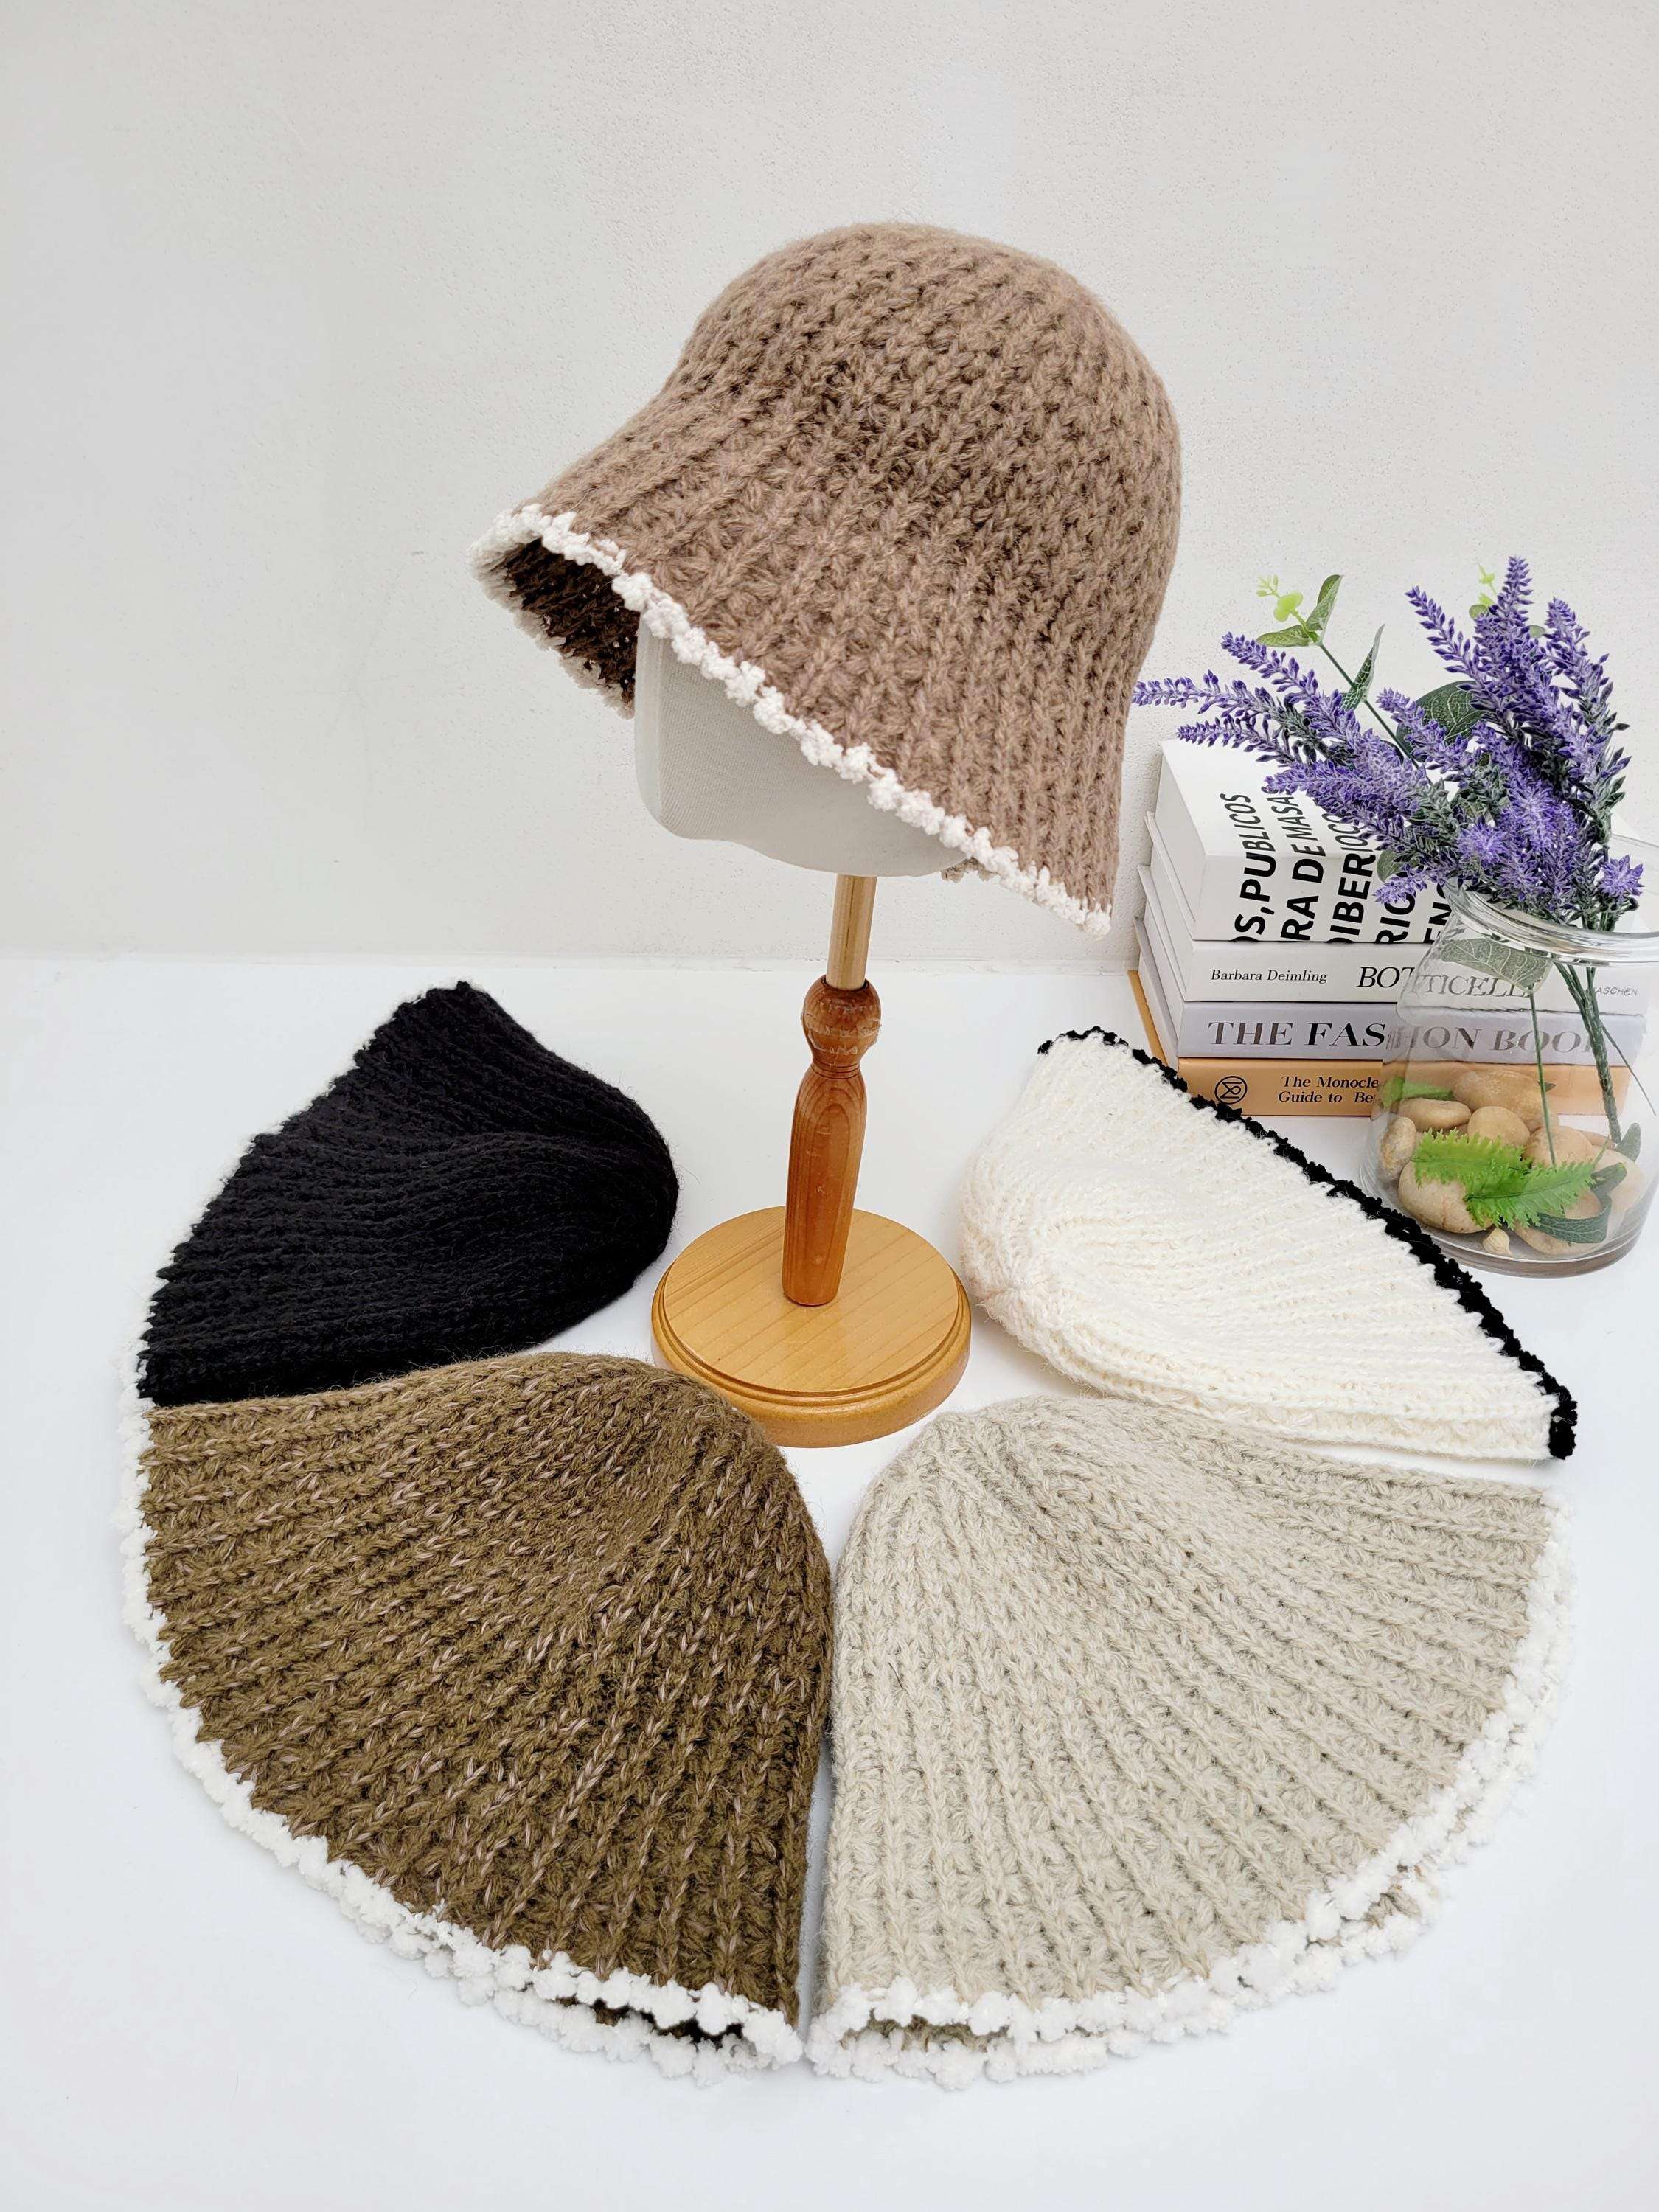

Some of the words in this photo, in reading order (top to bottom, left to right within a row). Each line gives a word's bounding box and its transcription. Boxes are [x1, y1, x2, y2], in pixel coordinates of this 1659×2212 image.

[1291, 844, 1326, 884] DE
[1211, 970, 1262, 981] Barbara
[1267, 970, 1328, 984] Deimling
[1356, 966, 1531, 998] BOTTICELL
[1208, 1022, 1293, 1046] THE
[1281, 1076, 1311, 1088] The
[1316, 1076, 1379, 1088] Monocle
[1278, 1091, 1323, 1103] Guide
[1328, 1091, 1343, 1103] to
[1354, 1091, 1376, 1104] Be
